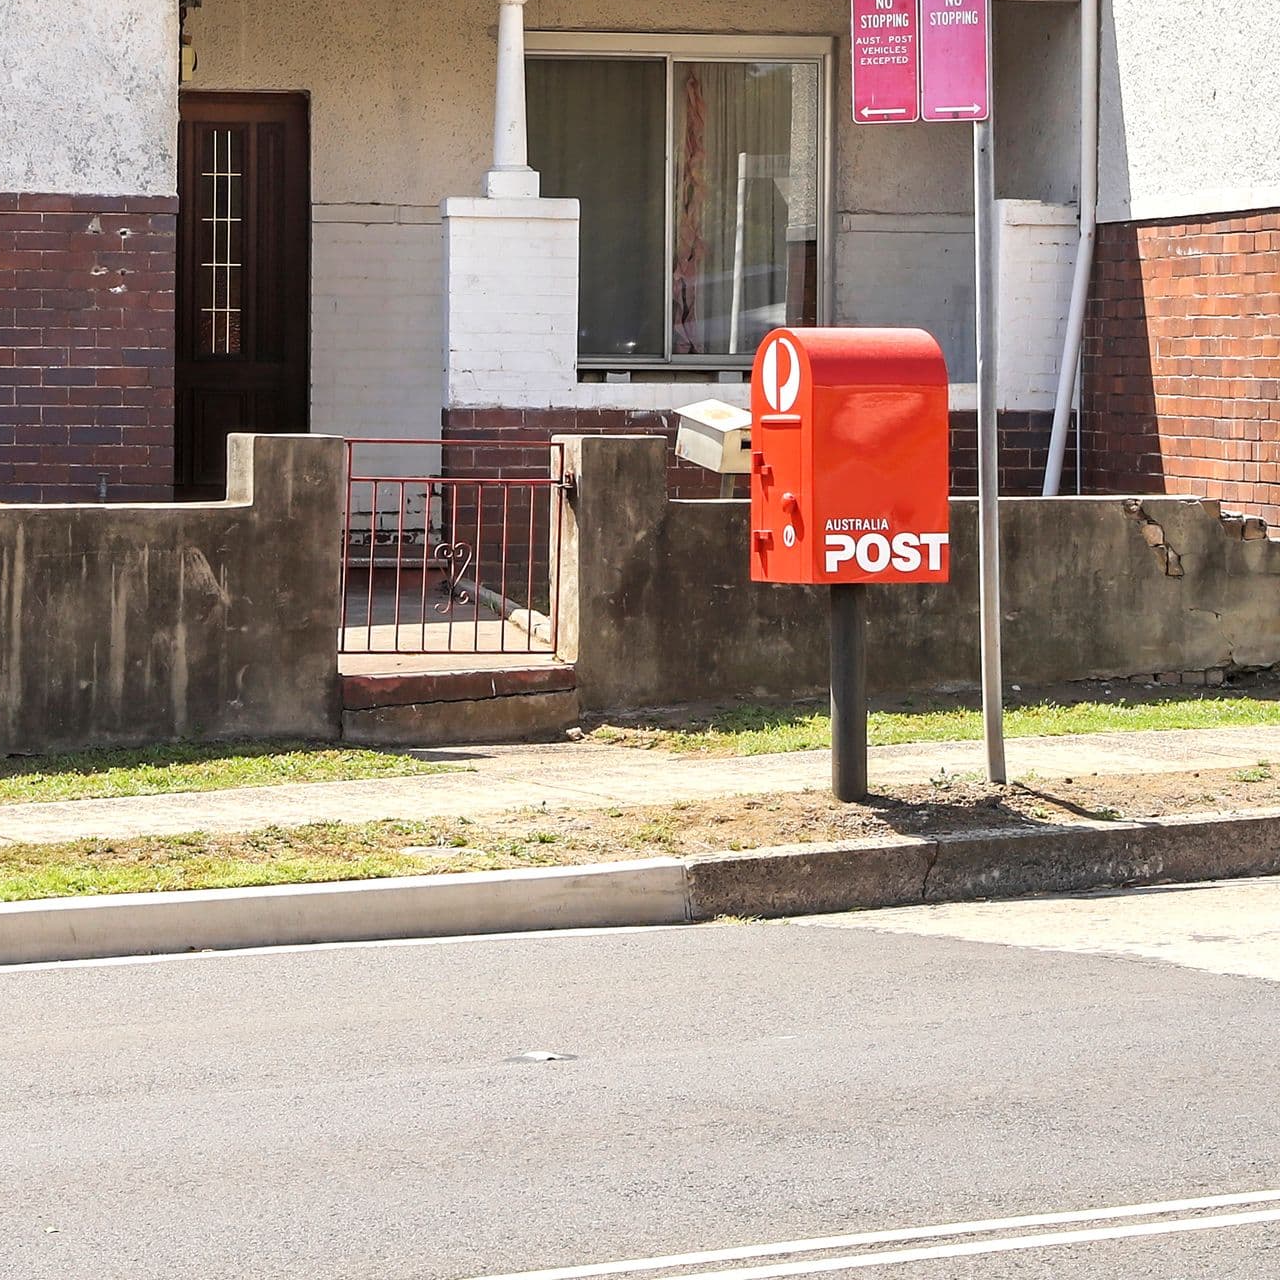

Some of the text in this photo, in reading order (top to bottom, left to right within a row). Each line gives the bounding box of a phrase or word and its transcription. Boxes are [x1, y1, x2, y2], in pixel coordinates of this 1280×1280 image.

[860, 13, 909, 29] STOPPING
[929, 10, 978, 26] STOPPING
[856, 35, 912, 45] AUST. POST
[862, 46, 907, 55] VEHICLES
[860, 56, 909, 65] EXCEPTED
[825, 518, 889, 531] AUSTRALIA
[825, 532, 949, 572] POST
